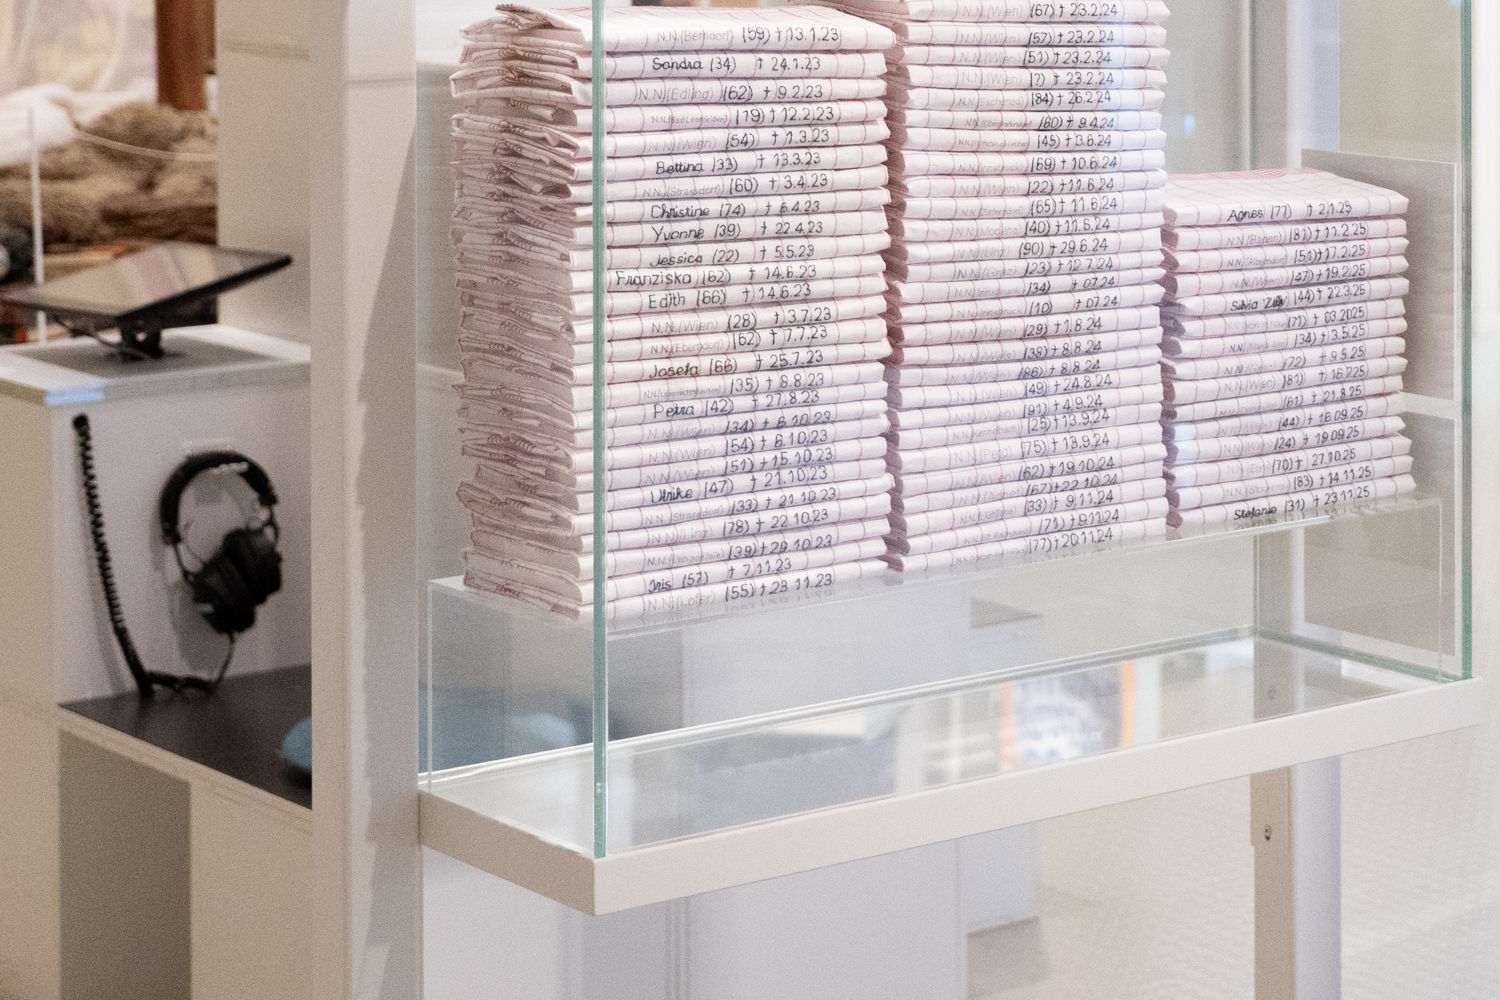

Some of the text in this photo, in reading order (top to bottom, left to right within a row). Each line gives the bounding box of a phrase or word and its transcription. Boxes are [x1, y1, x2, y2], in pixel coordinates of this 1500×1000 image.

[1030, 3, 1055, 18] (67)
[742, 26, 770, 45] (59)
[1028, 31, 1052, 45] (57)
[652, 57, 703, 71] Sandra
[710, 57, 736, 73] (34)
[1023, 49, 1049, 66] (51)
[1031, 92, 1054, 106] (84)
[736, 109, 765, 125] (19)
[726, 132, 755, 150] (54)
[1037, 134, 1060, 149] (45)
[656, 161, 704, 175] Bettina
[712, 157, 738, 173] (33)
[1031, 156, 1056, 172] (69)
[1028, 180, 1053, 194] (22)
[651, 204, 710, 220] Christine
[720, 203, 745, 217] (74)
[1030, 198, 1056, 215] (65)
[1227, 209, 1263, 222] Agnes
[1271, 205, 1292, 219] (77)
[652, 225, 705, 241] Yvonne
[715, 223, 741, 239] (39)
[1025, 220, 1050, 236] (40)
[1289, 228, 1312, 241] (81)
[651, 253, 703, 267] Jessica
[712, 249, 739, 265] (22)
[1019, 242, 1044, 258] (90)
[1294, 248, 1317, 263] (51)
[1024, 260, 1050, 276] (23)
[615, 270, 691, 286] Franziska
[1291, 271, 1313, 285] (47)
[1029, 279, 1050, 294] (34)
[1293, 290, 1315, 305] (44)
[1030, 301, 1052, 315] (10)
[727, 313, 757, 330] (28)
[1023, 323, 1048, 337] (29)
[1294, 330, 1317, 345] (34)
[1023, 345, 1048, 359] (38)
[1282, 355, 1306, 369] (72)
[649, 363, 700, 379] Josefa
[1282, 371, 1304, 387] (81)
[730, 377, 759, 394] (35)
[1024, 381, 1049, 396] (49)
[653, 403, 694, 418] Petra
[705, 399, 734, 415] (42)
[1023, 402, 1048, 418] (91)
[1028, 415, 1053, 433] (25)
[1278, 413, 1300, 429] (44)
[726, 438, 755, 456] (54)
[1021, 440, 1046, 457] (75)
[1274, 433, 1296, 450] (24)
[725, 458, 754, 475] (51)
[1272, 455, 1293, 472] (70)
[1293, 470, 1314, 486] (83)
[704, 480, 734, 499] (47)
[731, 497, 758, 515] (33)
[1024, 497, 1047, 513] (33)
[1284, 496, 1305, 514] (31)
[723, 520, 749, 537] (78)
[728, 543, 756, 560] (39)
[1029, 536, 1053, 553] (77)
[683, 572, 708, 587] (57)
[725, 583, 754, 601] (55)
